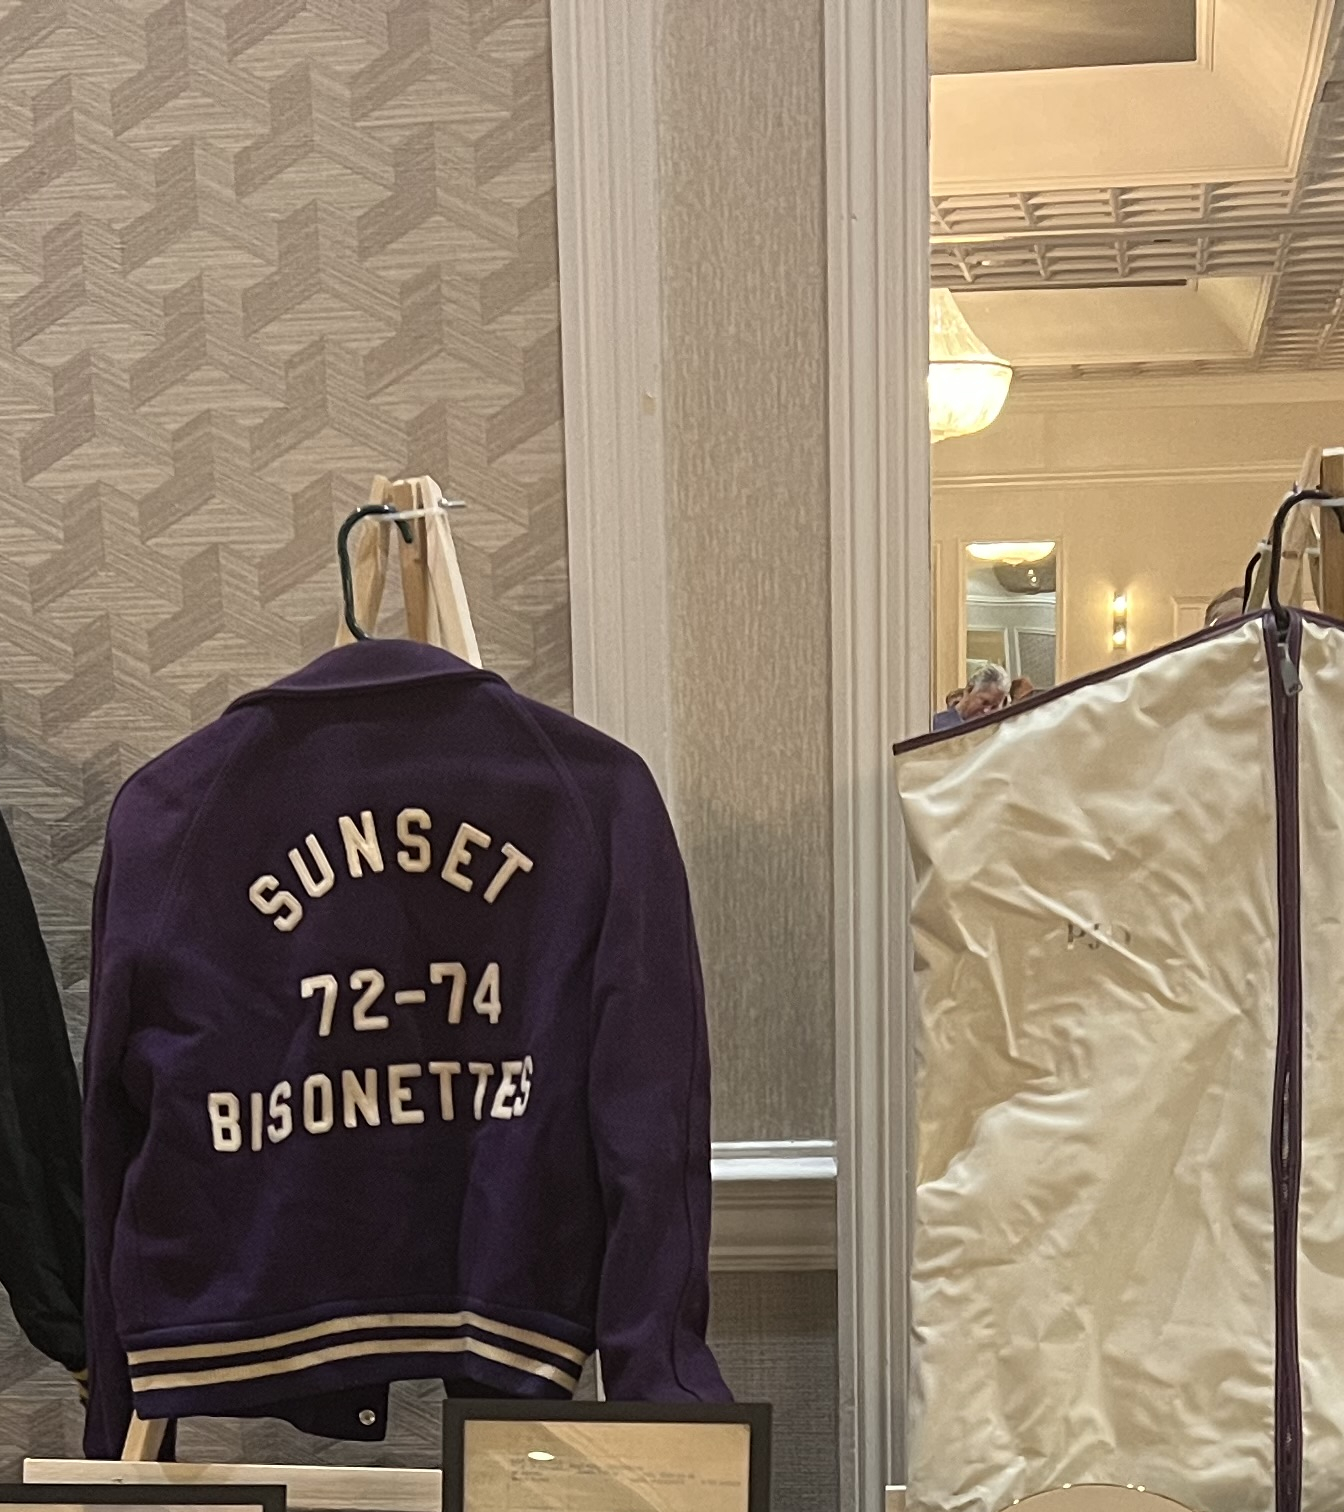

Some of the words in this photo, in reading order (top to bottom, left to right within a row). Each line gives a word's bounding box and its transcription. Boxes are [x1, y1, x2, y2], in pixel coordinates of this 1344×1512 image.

[249, 807, 534, 932] SUNSET
[300, 962, 503, 1037] 72-74
[207, 1055, 534, 1153] BISONETTES
